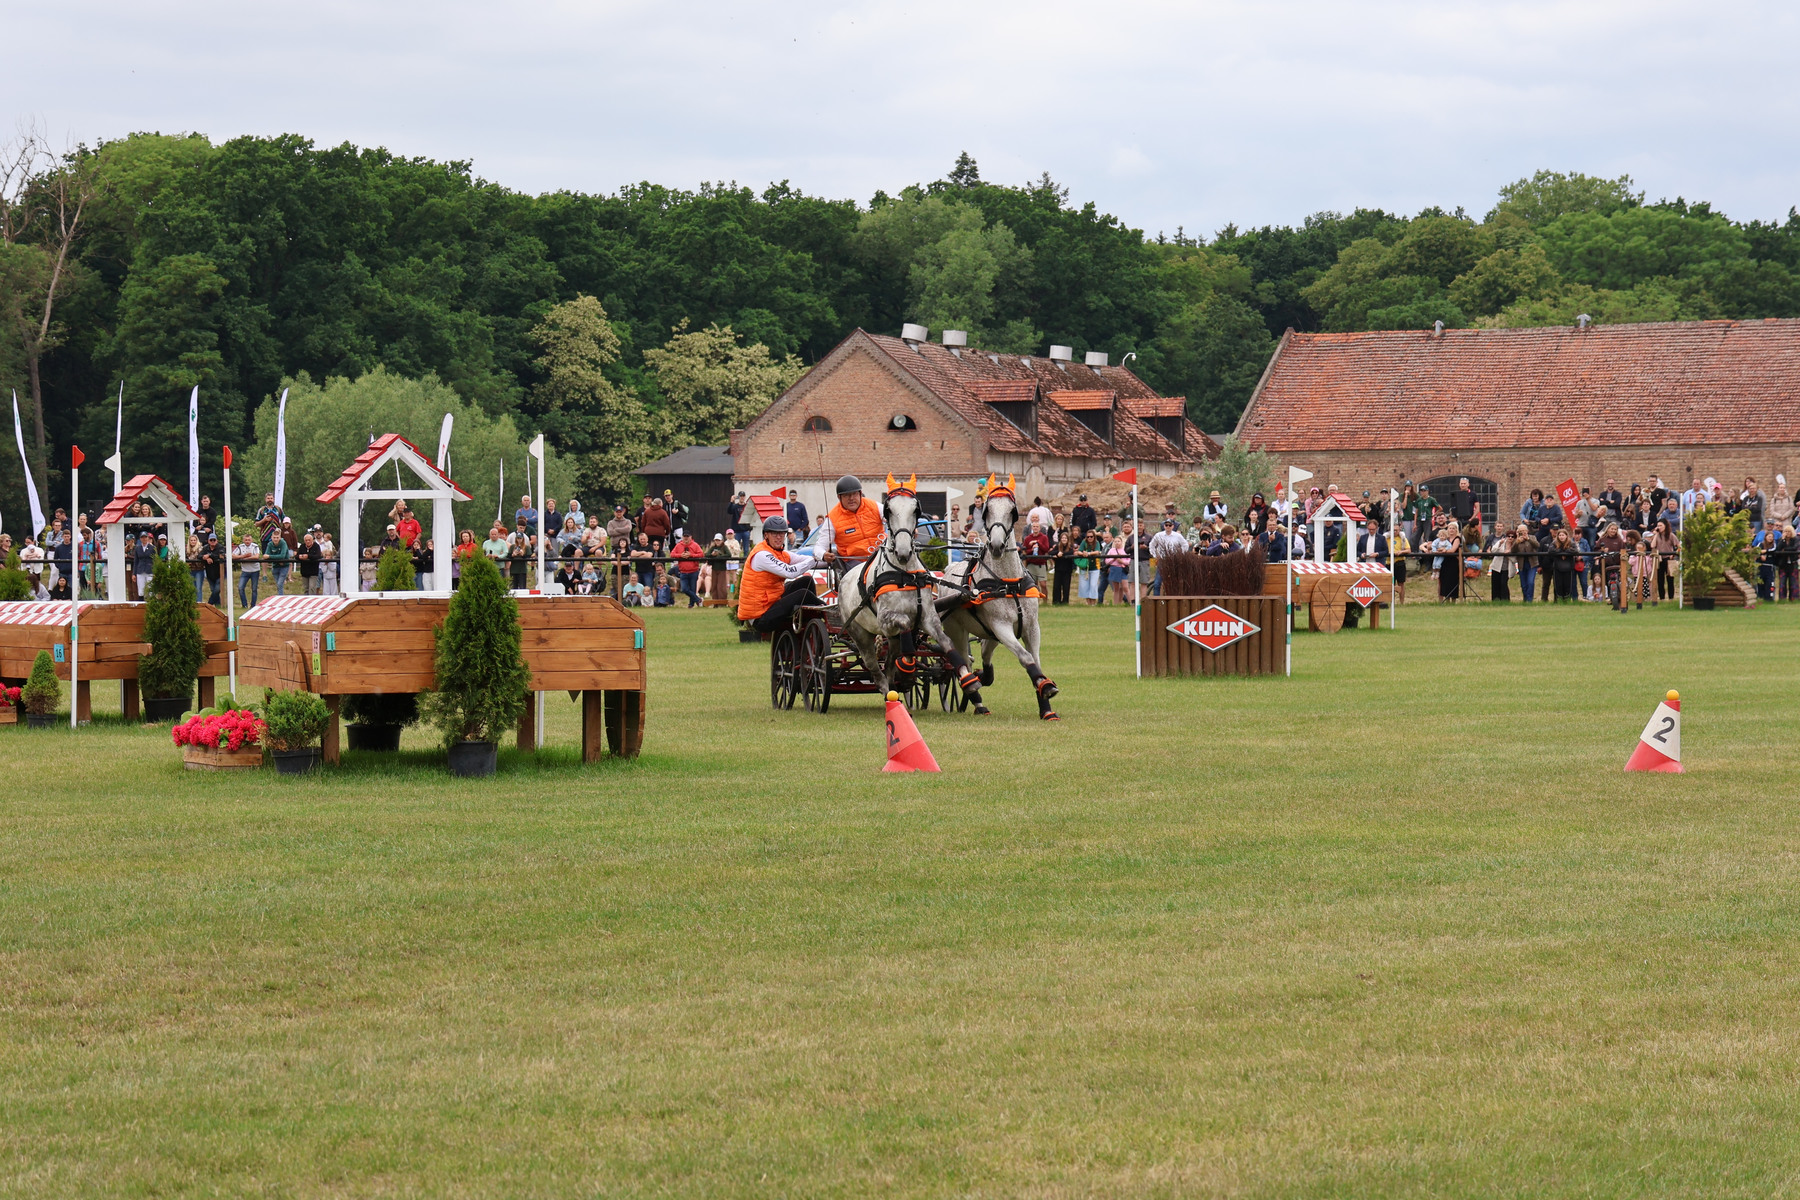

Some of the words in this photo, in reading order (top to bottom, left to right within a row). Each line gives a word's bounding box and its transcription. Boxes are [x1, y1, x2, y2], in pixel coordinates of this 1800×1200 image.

[1353, 586, 1376, 598] KUHN
[1184, 620, 1244, 637] KUHN
[55, 648, 63, 659] 16
[886, 719, 900, 747] 2
[1652, 716, 1675, 744] 2
